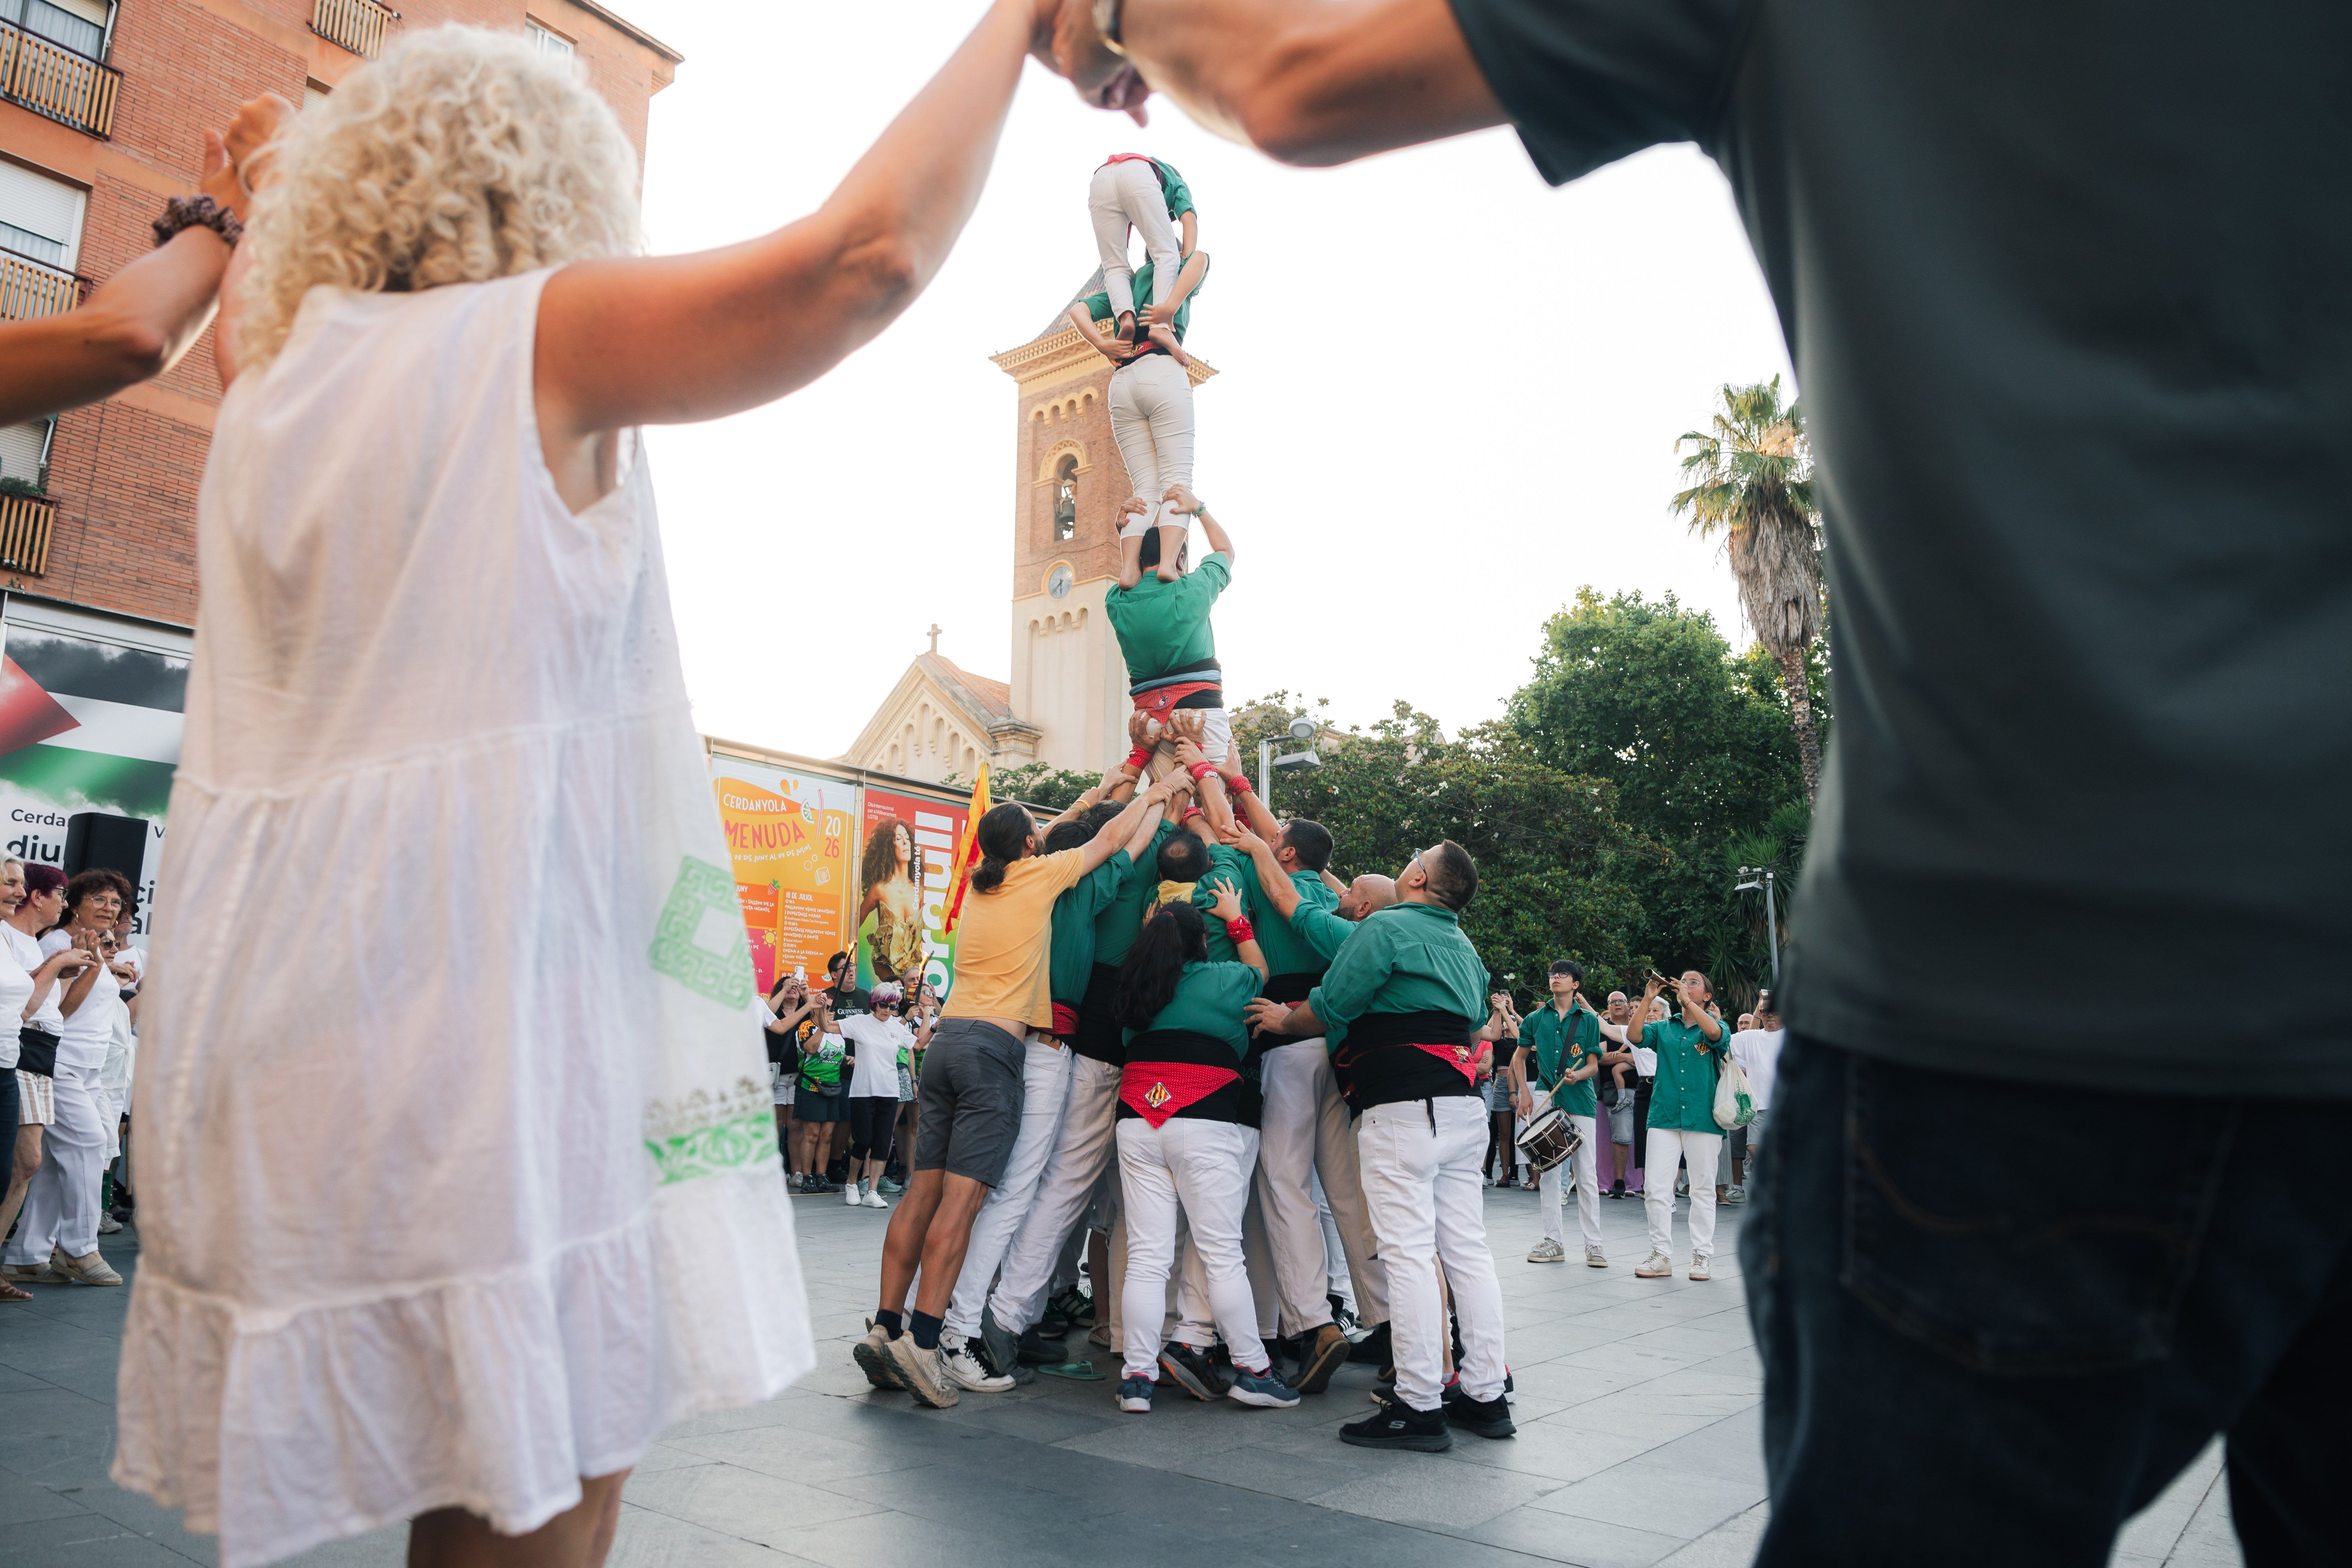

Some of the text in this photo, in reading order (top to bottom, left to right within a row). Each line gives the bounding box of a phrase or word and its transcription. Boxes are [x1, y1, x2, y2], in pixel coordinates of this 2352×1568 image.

[723, 793, 787, 812] CERDANYOLA
[874, 802, 894, 811] Internacional
[11, 809, 70, 827] Cerda
[825, 815, 841, 837] 20
[724, 819, 806, 849] MENUDA
[6, 834, 61, 863] diu
[753, 854, 768, 863] JUNY
[787, 848, 795, 857] DE
[796, 844, 812, 856] JULIOL
[824, 837, 840, 859] 26
[912, 846, 921, 910] Cerdanyola té
[736, 884, 748, 893] JUNY
[799, 893, 813, 901] JULIOL
